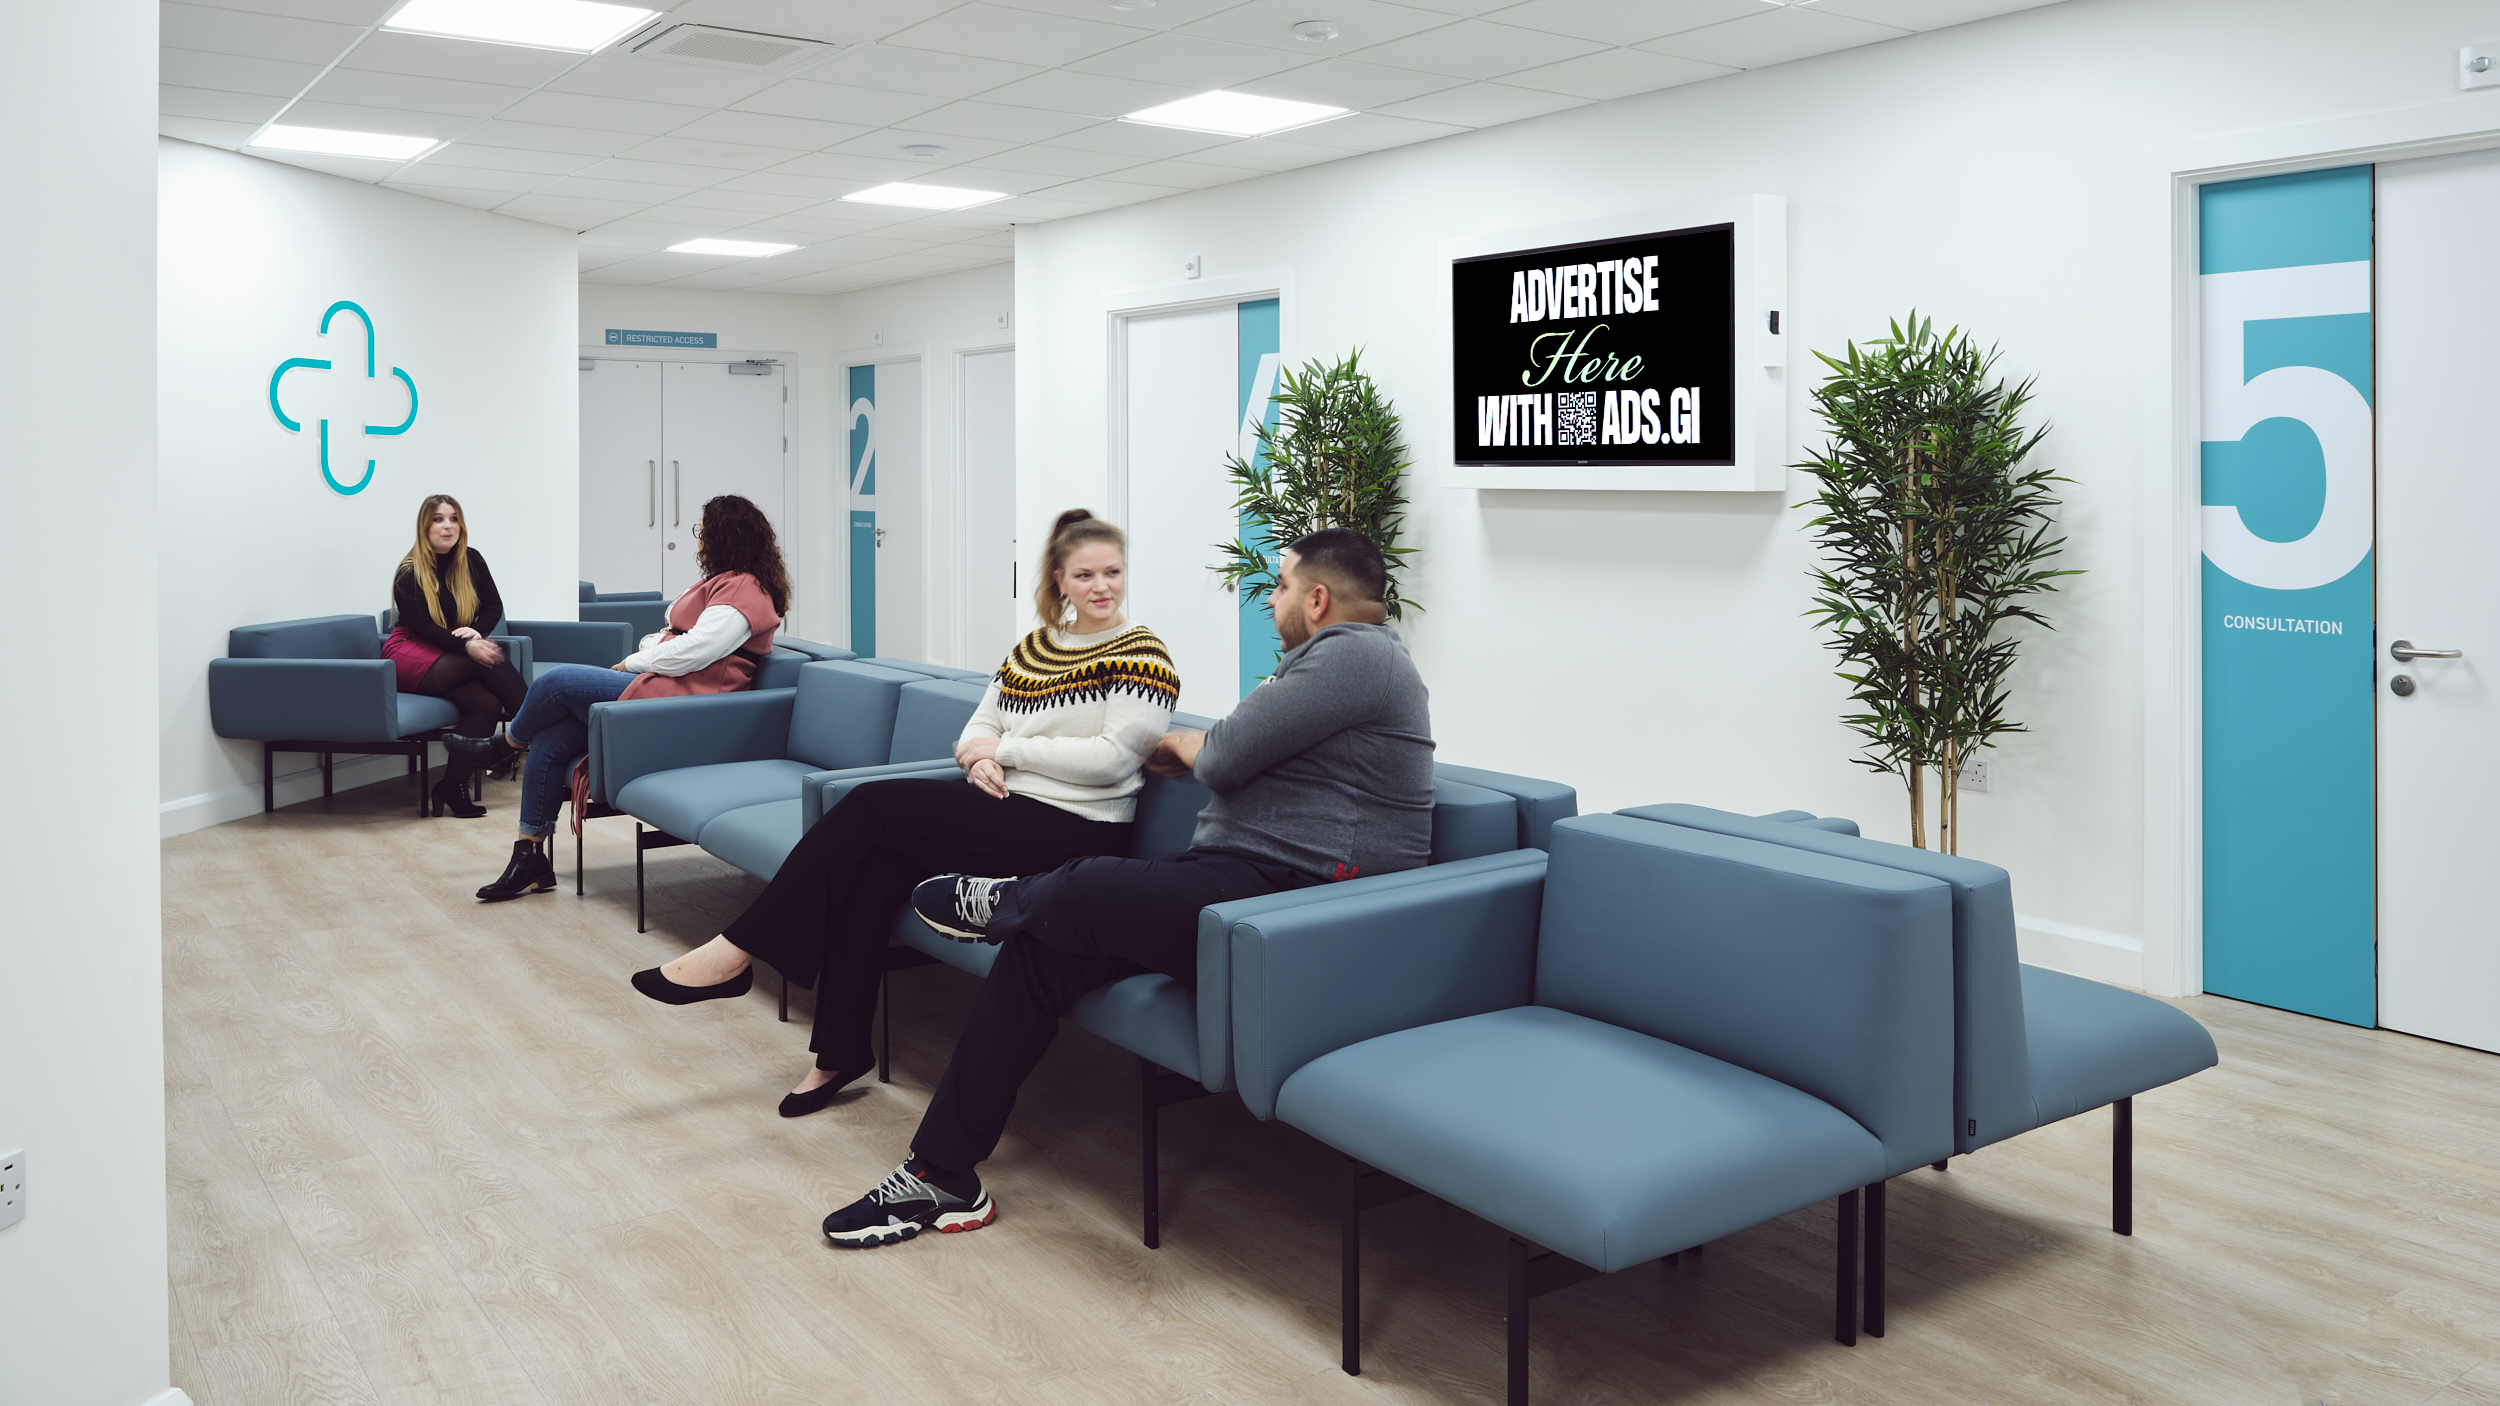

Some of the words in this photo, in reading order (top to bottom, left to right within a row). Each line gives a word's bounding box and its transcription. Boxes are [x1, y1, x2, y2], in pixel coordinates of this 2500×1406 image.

[1510, 255, 1659, 323] ADVERTISE
[626, 334, 673, 344] RESTRICTED
[674, 336, 704, 345] ACCESS
[1521, 324, 1645, 388] Here
[1478, 393, 1553, 447] WITH
[1602, 387, 1700, 445] ADS.GI
[2200, 260, 2373, 590] 5
[850, 397, 876, 511] 2
[2223, 614, 2343, 635] CONSULTATION
